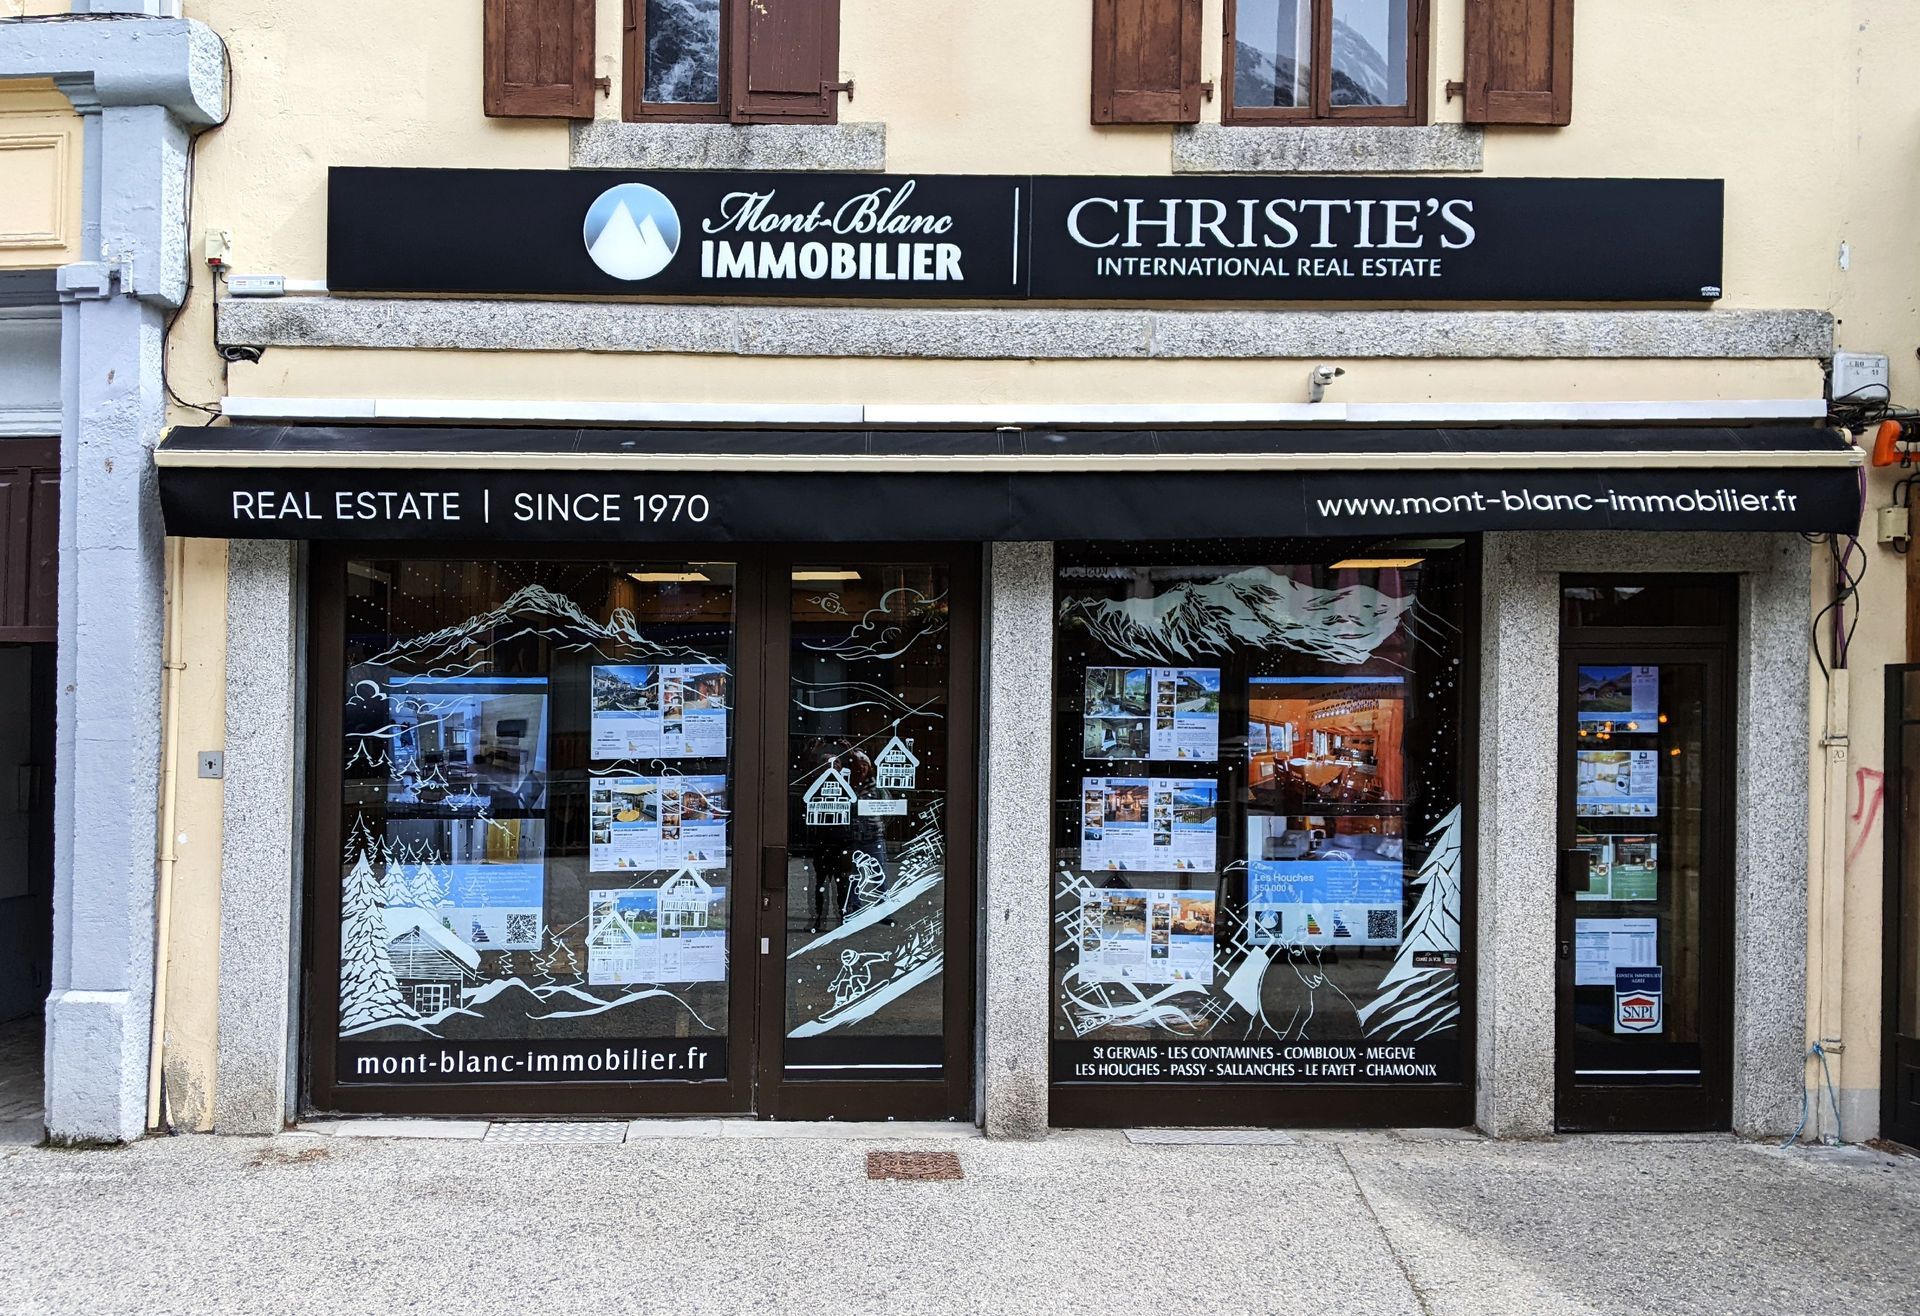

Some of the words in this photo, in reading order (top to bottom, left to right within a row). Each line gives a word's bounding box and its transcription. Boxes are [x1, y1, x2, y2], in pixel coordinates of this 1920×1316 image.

[702, 180, 953, 235] Mont-Blanc
[1067, 197, 1476, 249] CHRISTIE'S
[701, 240, 963, 281] IMMOBILIER
[1097, 257, 1289, 277] INTERNATIONAL
[1298, 257, 1355, 277] REAL
[1363, 257, 1442, 277] ESTATE
[232, 491, 322, 520] REAL
[336, 491, 461, 521] ESTATE
[513, 492, 621, 522] SINCE
[634, 493, 710, 523] 1970
[1316, 488, 1798, 518] www.mont-blanc-immobilier.fr
[1622, 1006, 1654, 1019] SNPI
[356, 1047, 708, 1074] mont-blanc-immobilier.fr
[1106, 1046, 1158, 1060] GERVAIS
[1168, 1047, 1188, 1060] LES
[1191, 1046, 1273, 1060] CONTAMINES
[1284, 1046, 1356, 1060] COMBLOUX
[1366, 1046, 1416, 1060] MEGEVE
[1075, 1063, 1096, 1076] LES
[1099, 1063, 1160, 1077] HOUCHES
[1171, 1063, 1207, 1076] PASSY
[1216, 1063, 1295, 1077] SALLANCHES
[1306, 1063, 1319, 1076] LE
[1322, 1063, 1356, 1076] FAYET
[1366, 1063, 1437, 1077] CHAMONIX
